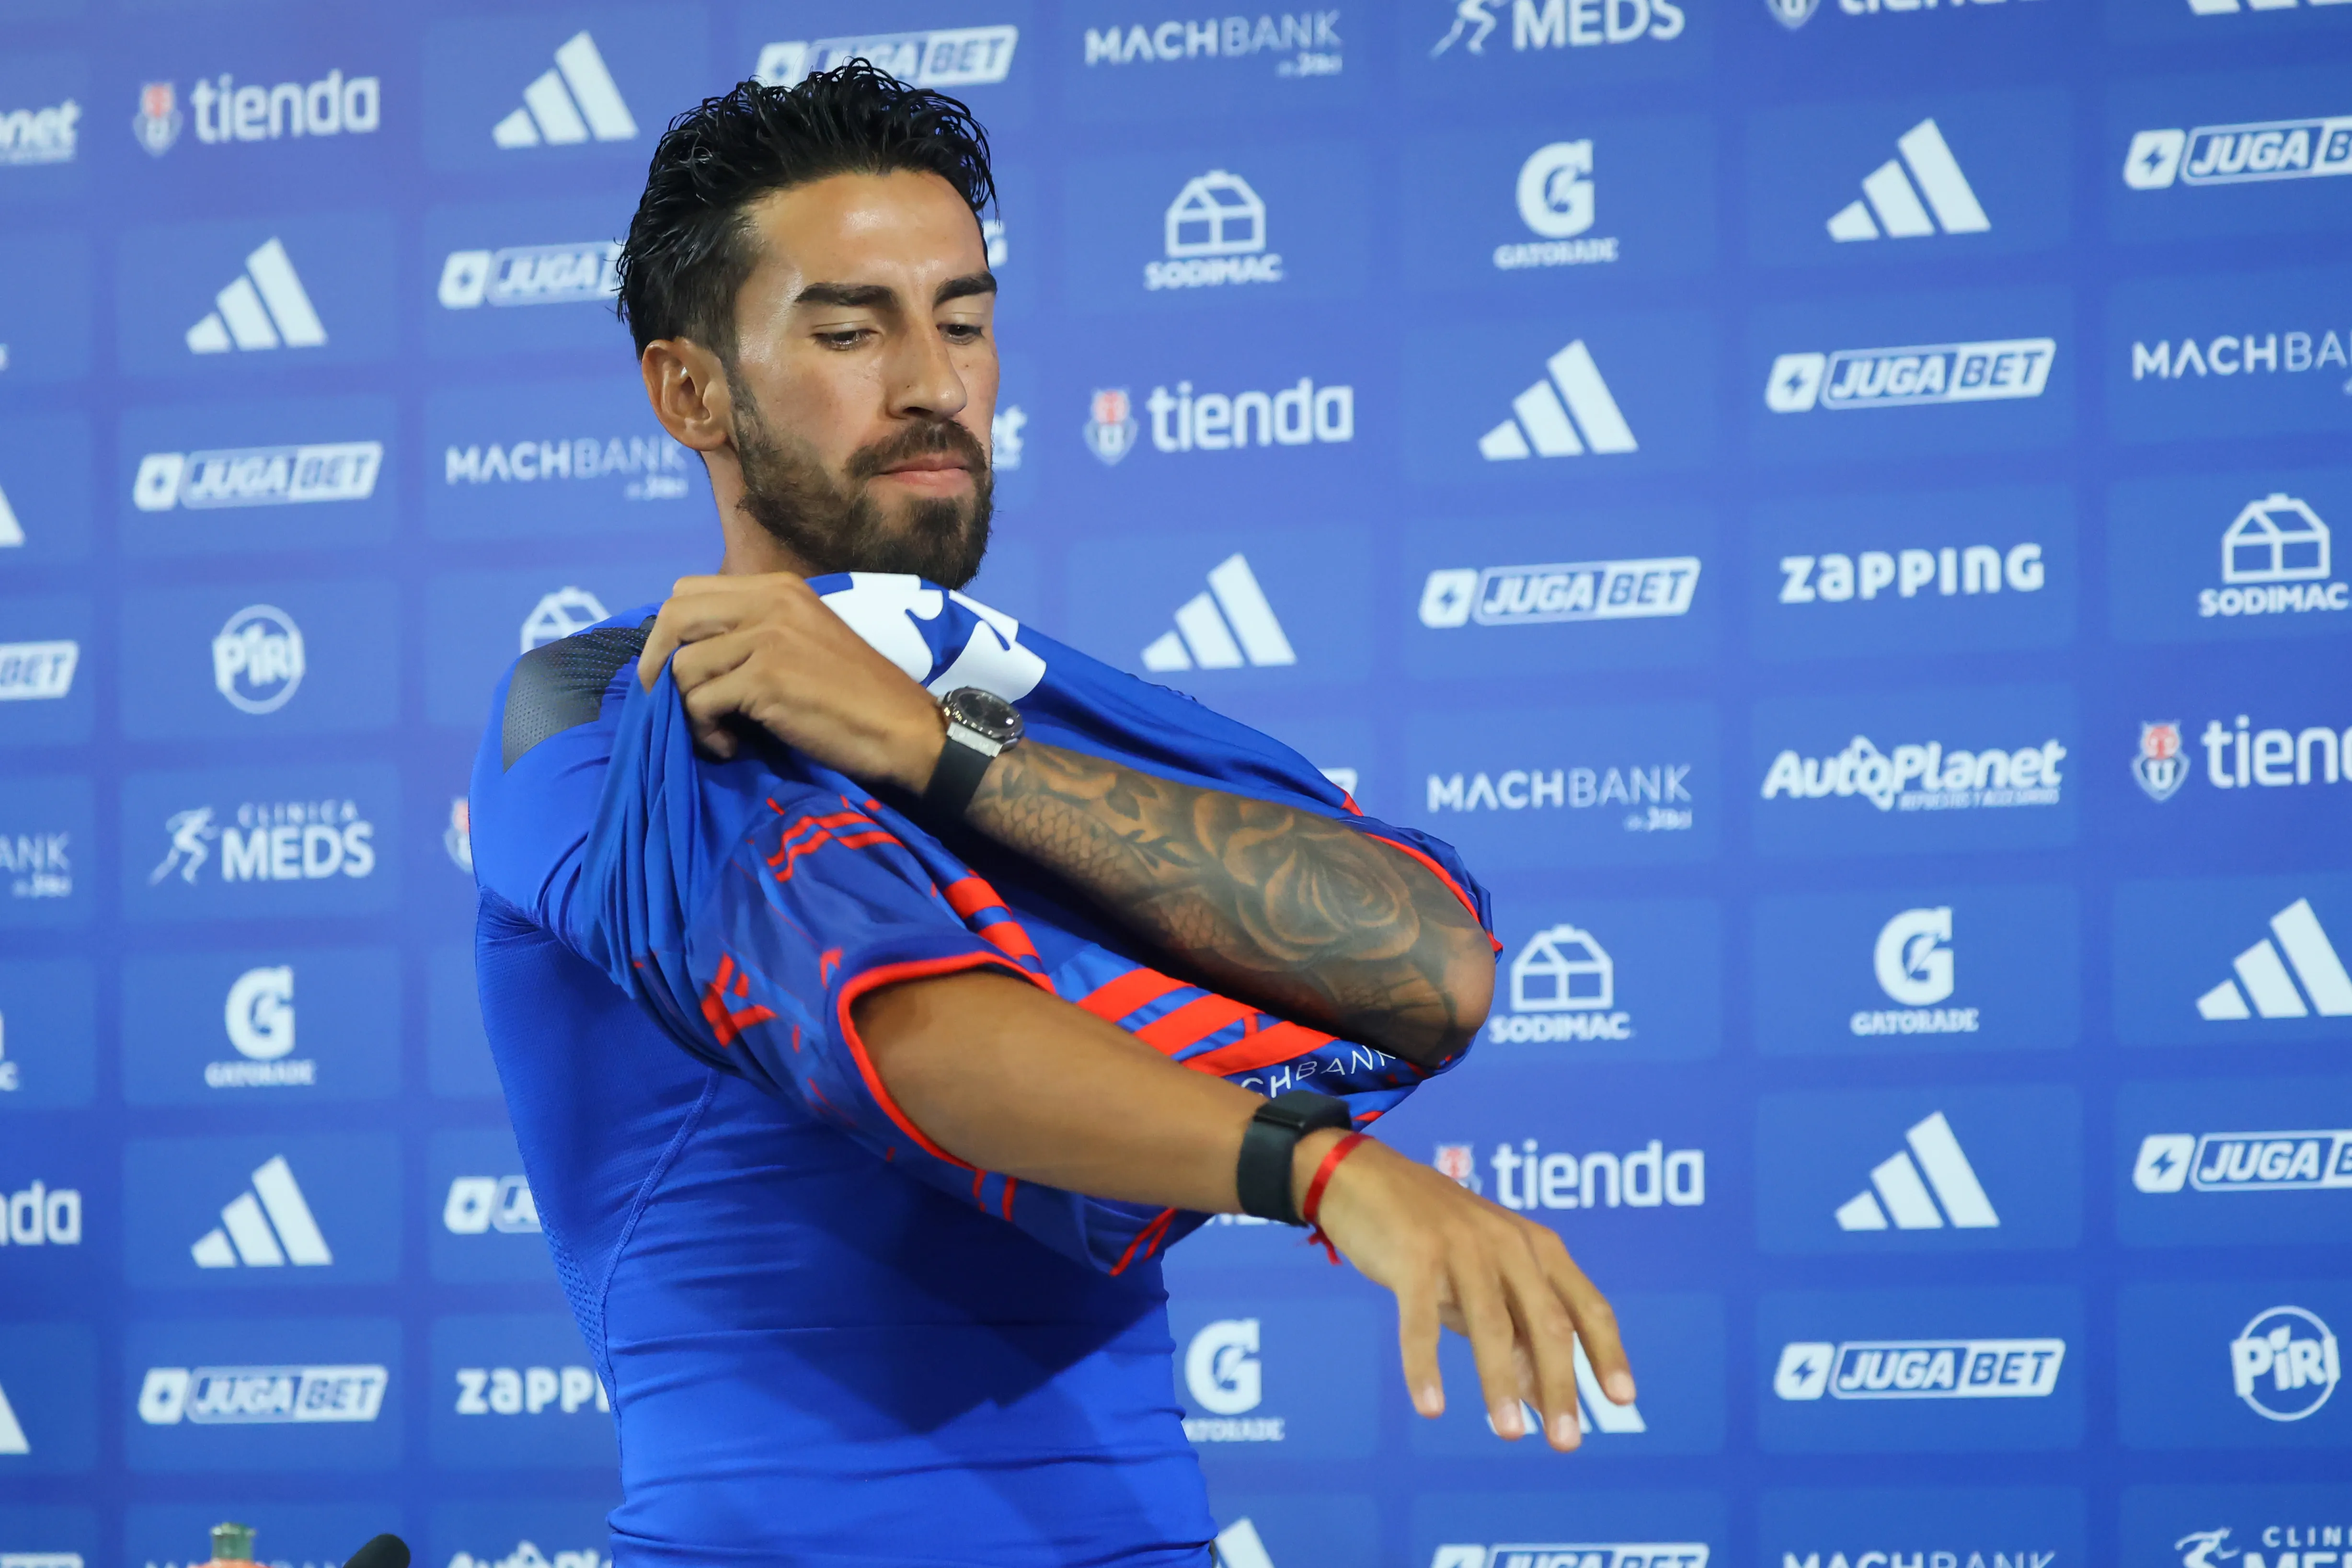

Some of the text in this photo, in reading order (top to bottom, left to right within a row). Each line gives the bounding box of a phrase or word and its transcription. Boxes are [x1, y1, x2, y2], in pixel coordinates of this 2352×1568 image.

[1085, 12, 1341, 64] MACHBANK
[190, 69, 380, 144] tienda
[1146, 255, 1281, 290] SODIMAC
[1494, 237, 1619, 270] GATORADE
[1146, 378, 1354, 453] tienda
[446, 435, 686, 485] MACHBANK
[2199, 581, 2350, 617] SODIMAC
[2201, 714, 2352, 789] tien
[1427, 765, 1692, 813] MACHBANK
[238, 800, 359, 828] CLINICA
[222, 820, 375, 882] MEDS
[1488, 1012, 1631, 1044] SODIMAC
[1851, 1008, 1979, 1036] GATORADE
[1492, 1139, 1705, 1209] tienda
[1181, 1418, 1285, 1442] ATORADE
